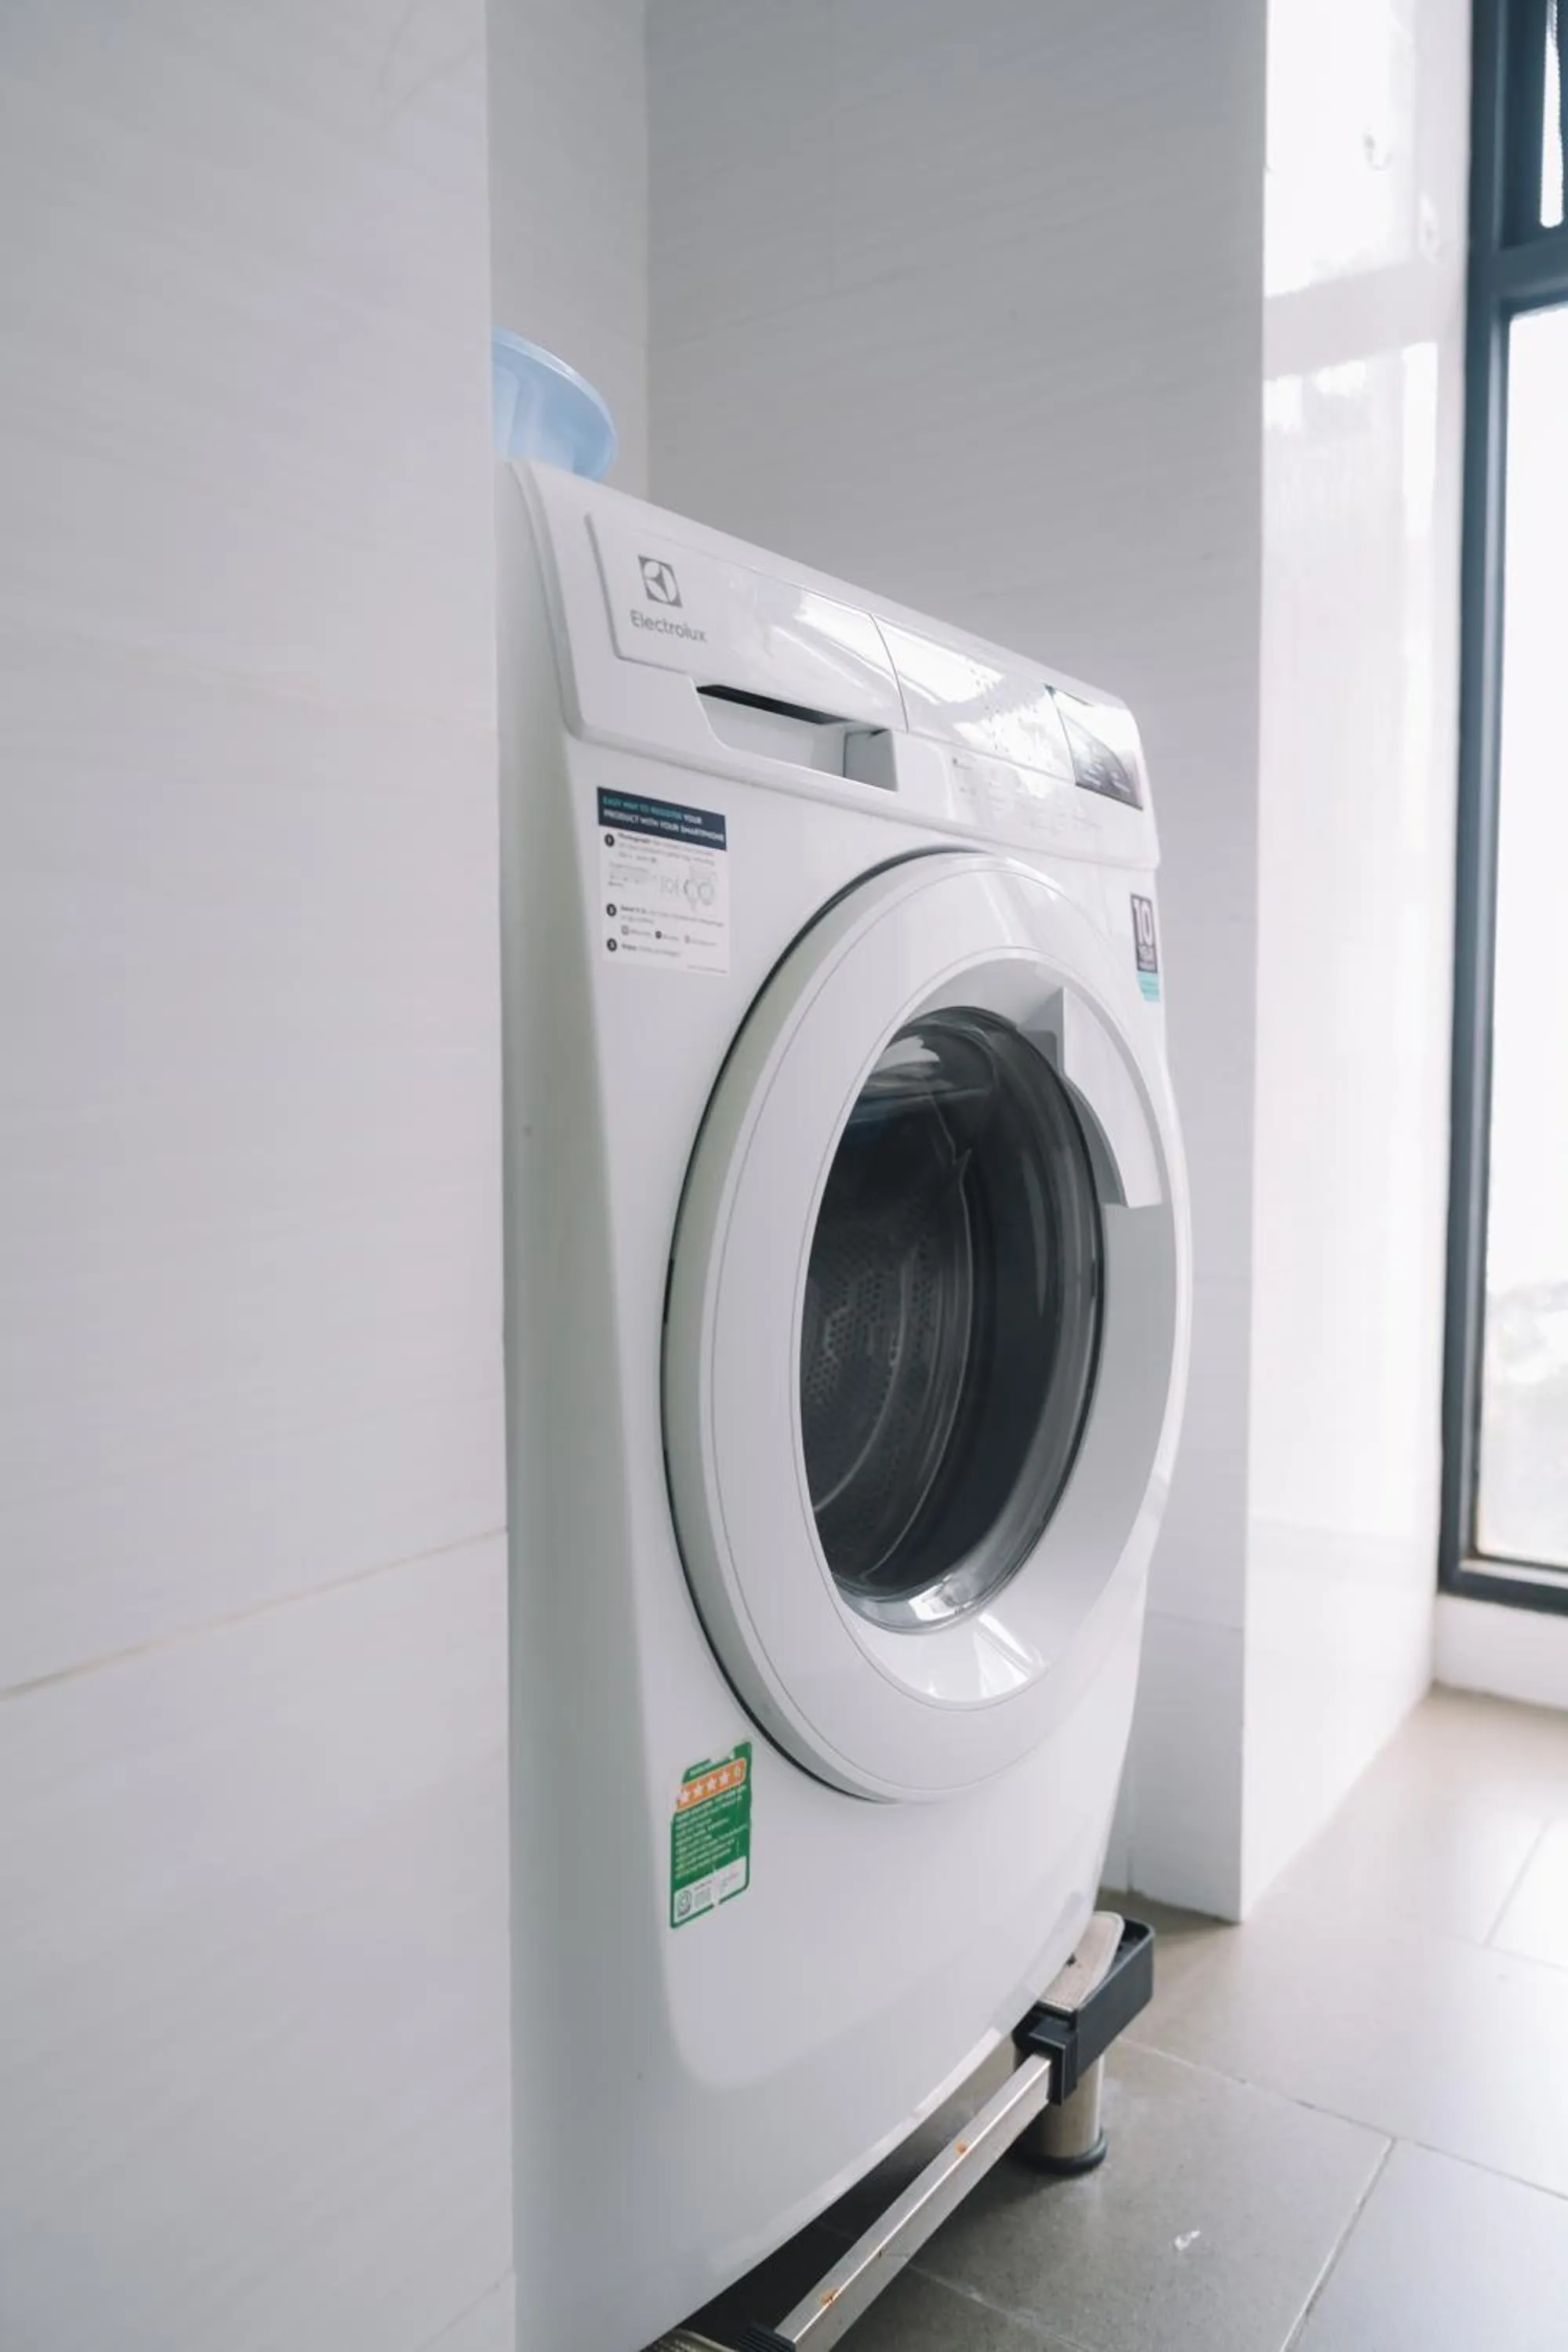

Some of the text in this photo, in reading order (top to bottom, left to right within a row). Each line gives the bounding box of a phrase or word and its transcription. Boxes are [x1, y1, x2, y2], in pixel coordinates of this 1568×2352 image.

[630, 609, 707, 643] Electrolux
[603, 808, 725, 842] PRODUCT WITH YOUR SMARTPHONE
[683, 814, 702, 824] YOUR
